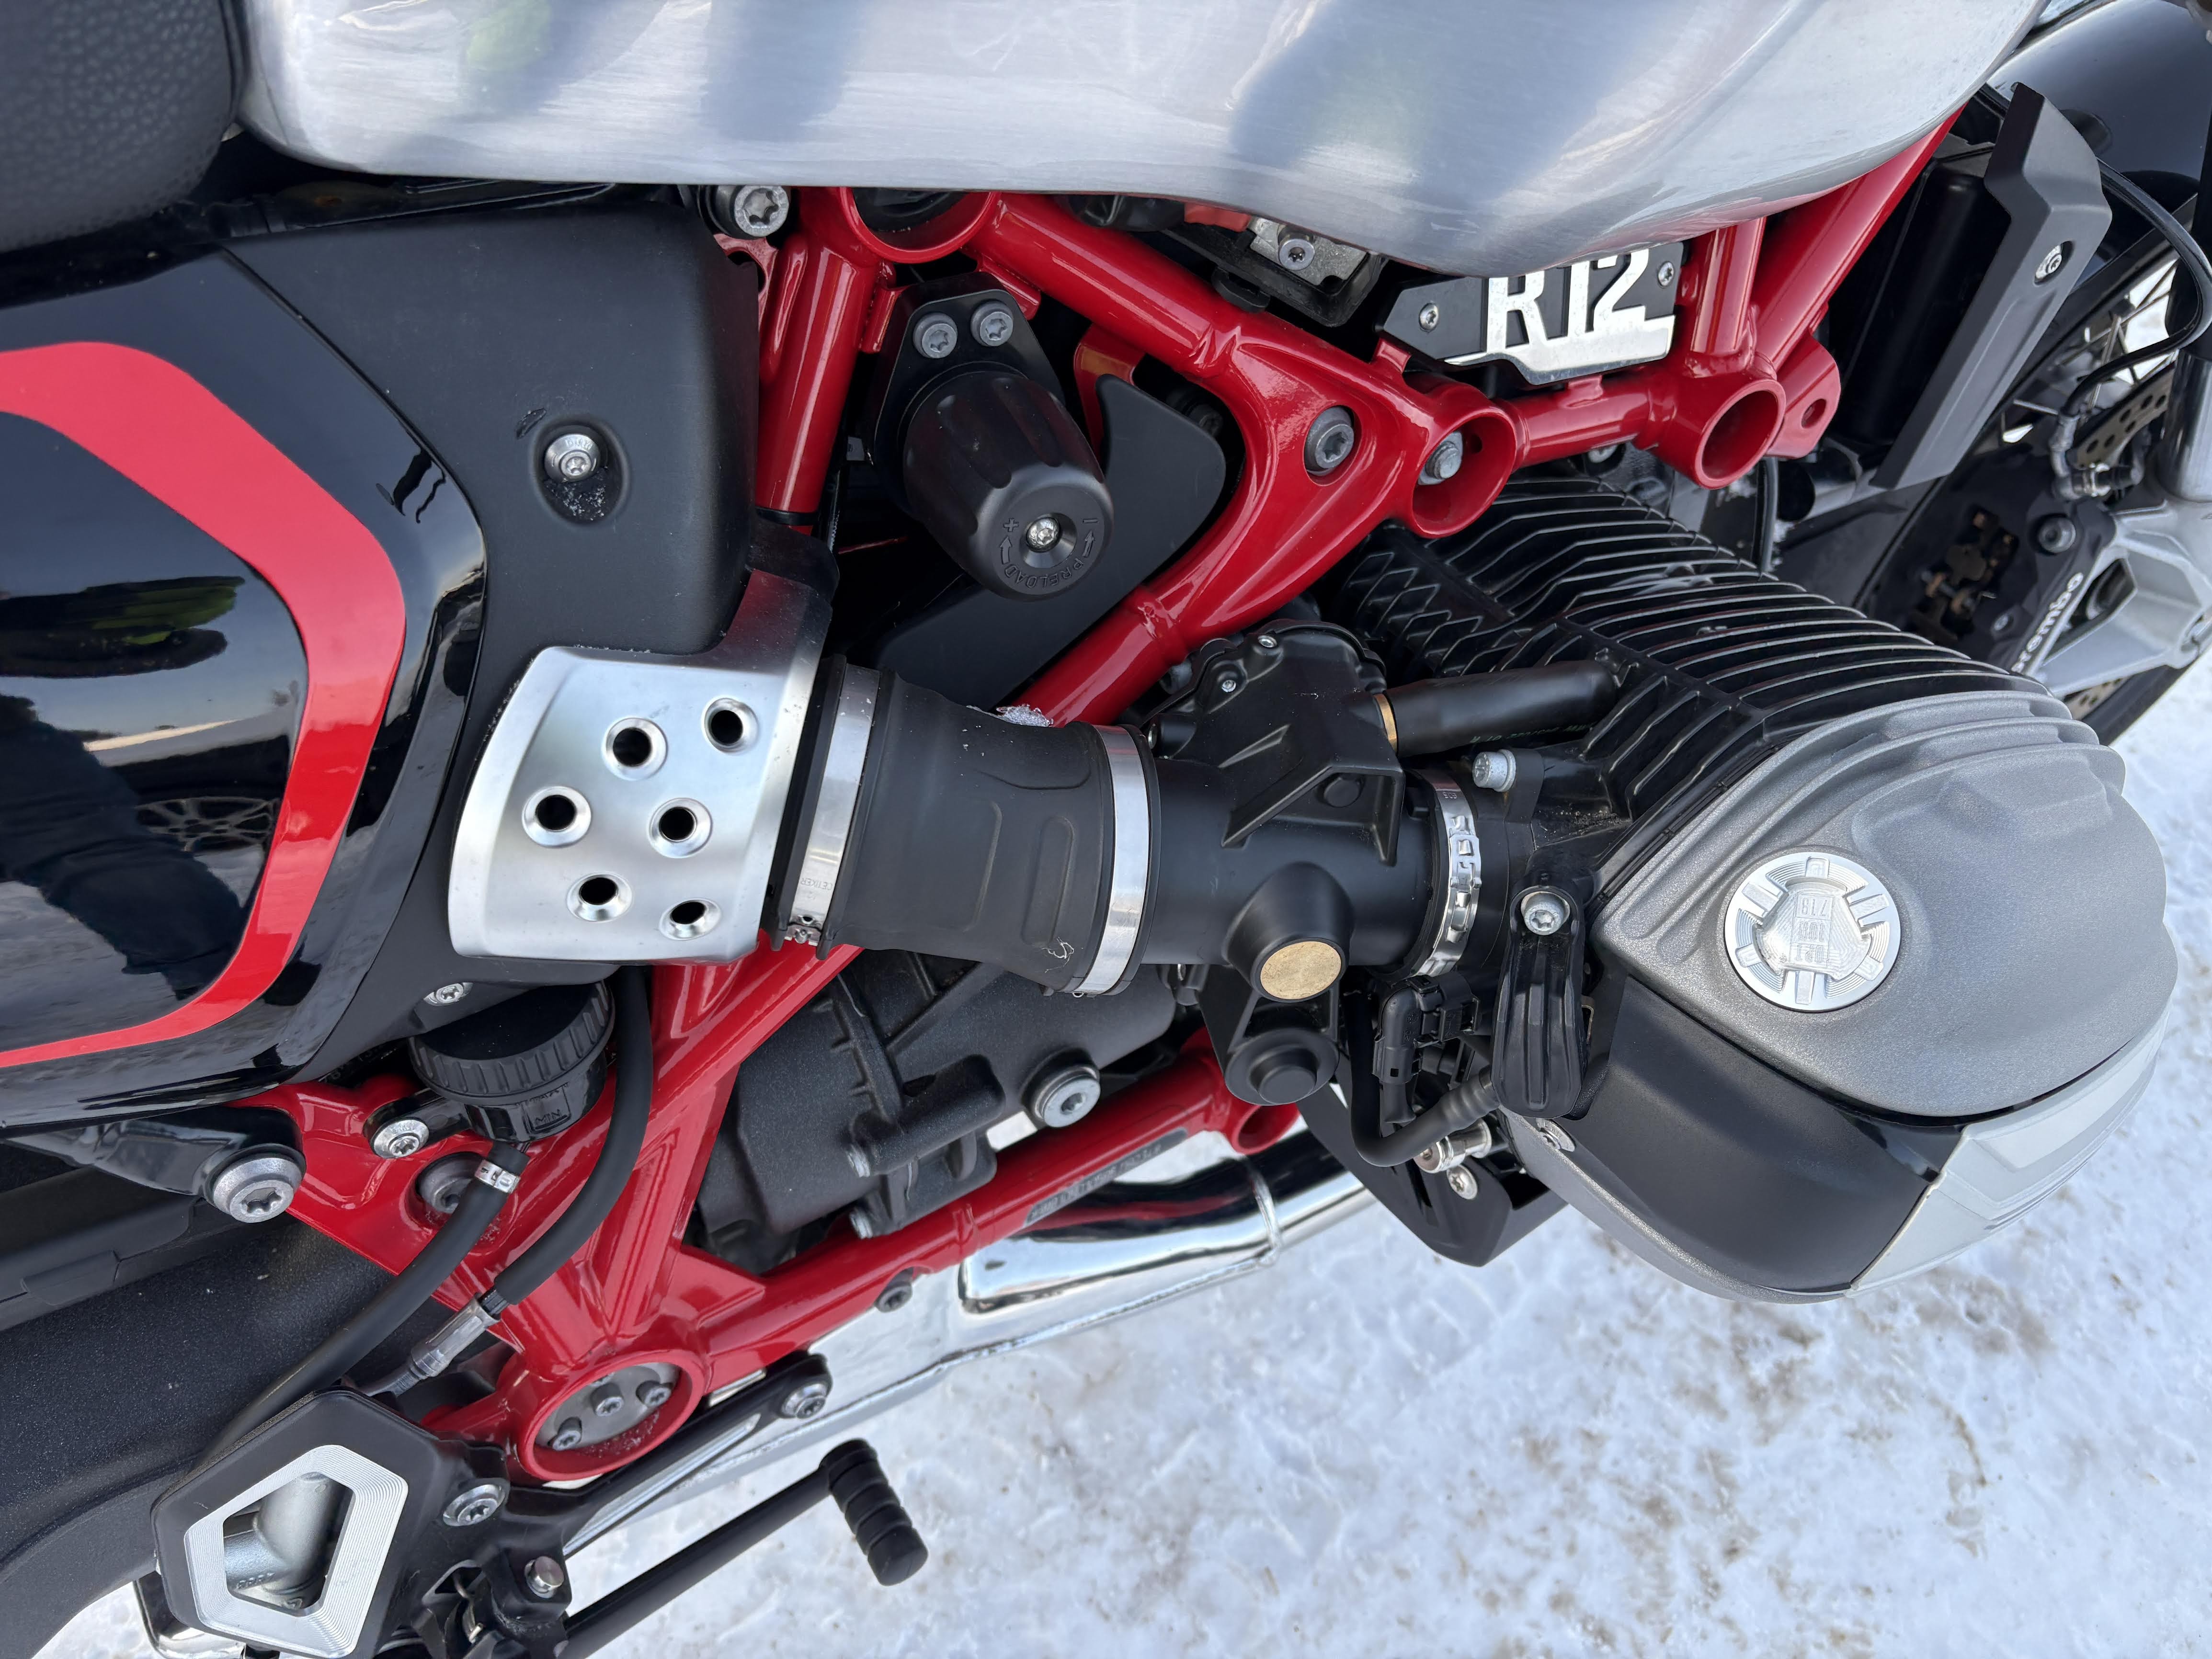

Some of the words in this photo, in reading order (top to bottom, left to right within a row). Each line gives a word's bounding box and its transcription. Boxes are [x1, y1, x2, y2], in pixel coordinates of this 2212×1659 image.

[1004, 558, 1084, 588] PRELOAD
[1802, 897, 1827, 917] 719
[535, 1108, 561, 1126] MIN
